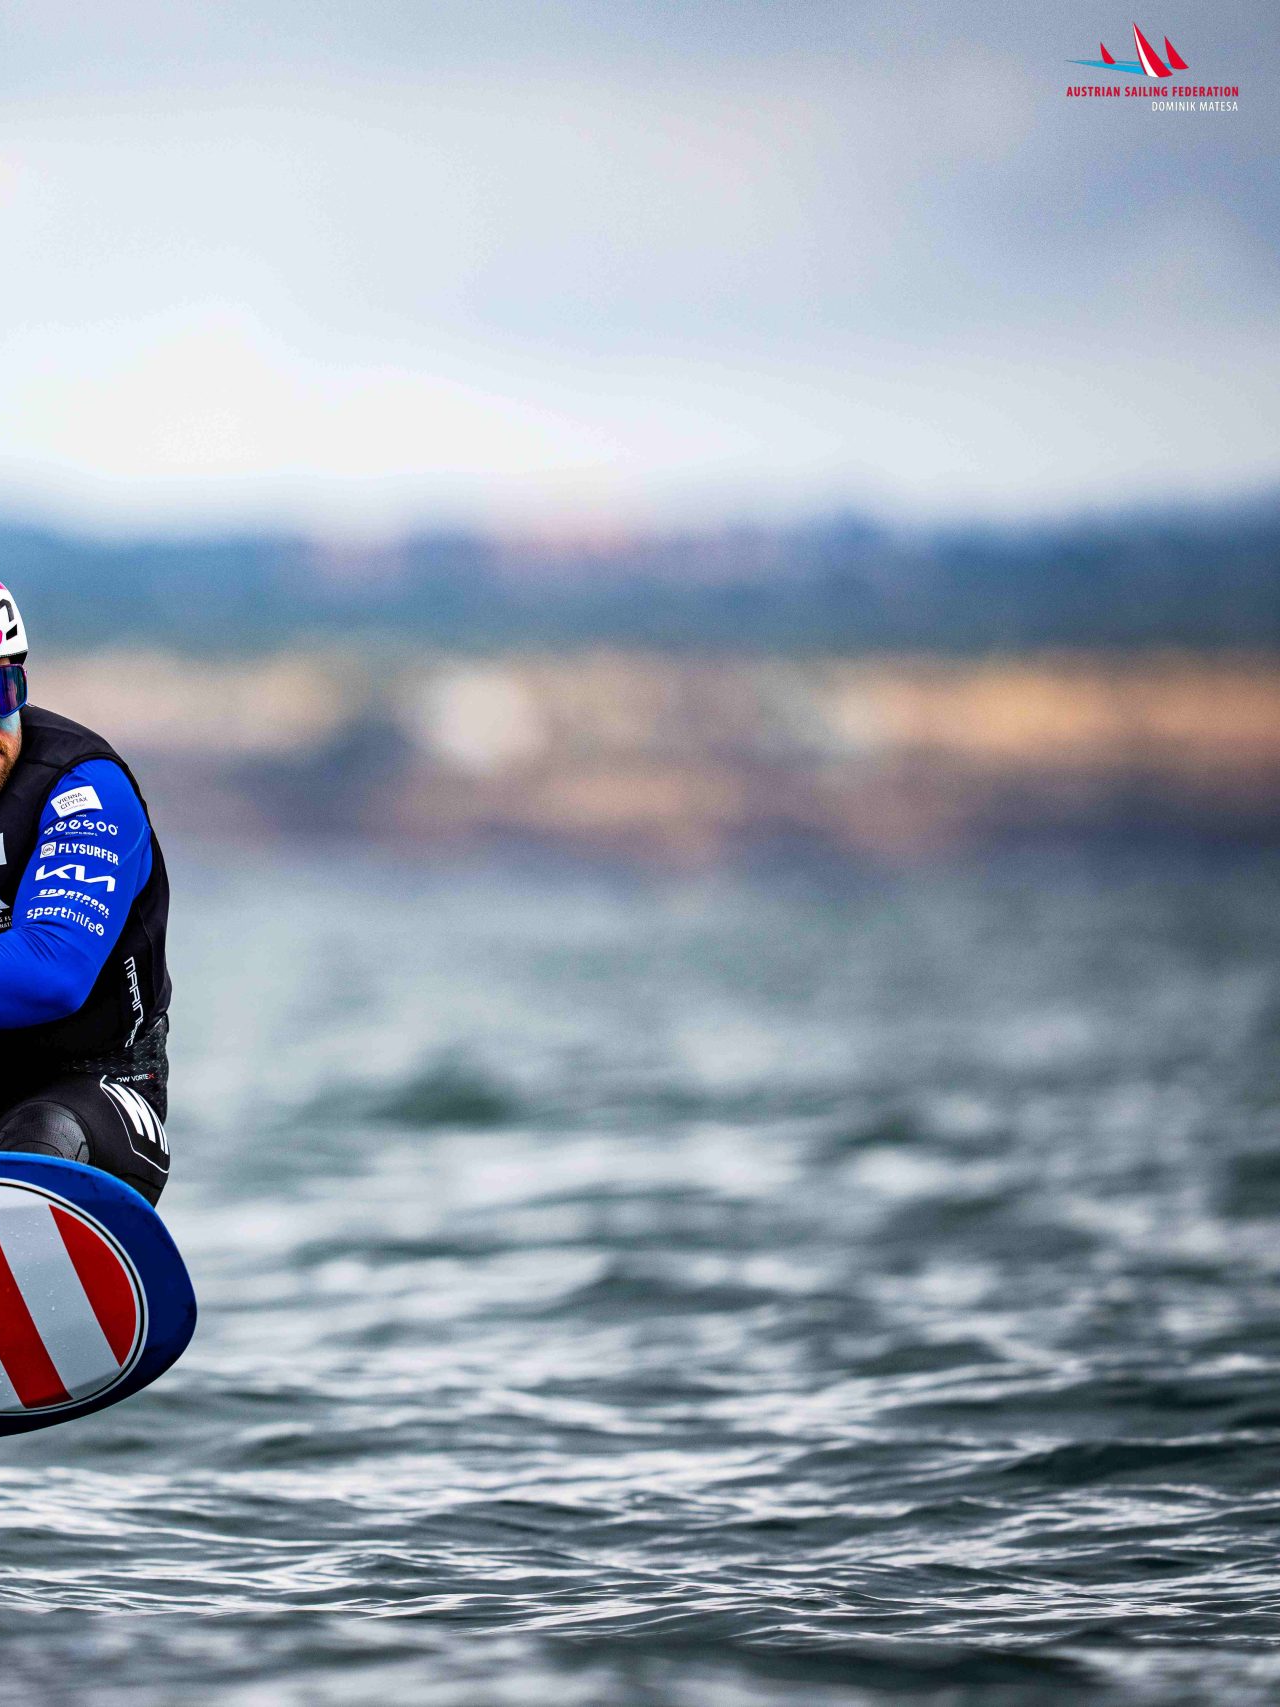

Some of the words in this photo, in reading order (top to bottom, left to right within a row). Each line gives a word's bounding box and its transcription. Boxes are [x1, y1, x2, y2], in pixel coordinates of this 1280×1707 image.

[58, 843, 119, 866] FLYSURFER
[35, 863, 116, 892] KIA
[26, 907, 95, 933] sporthilfe
